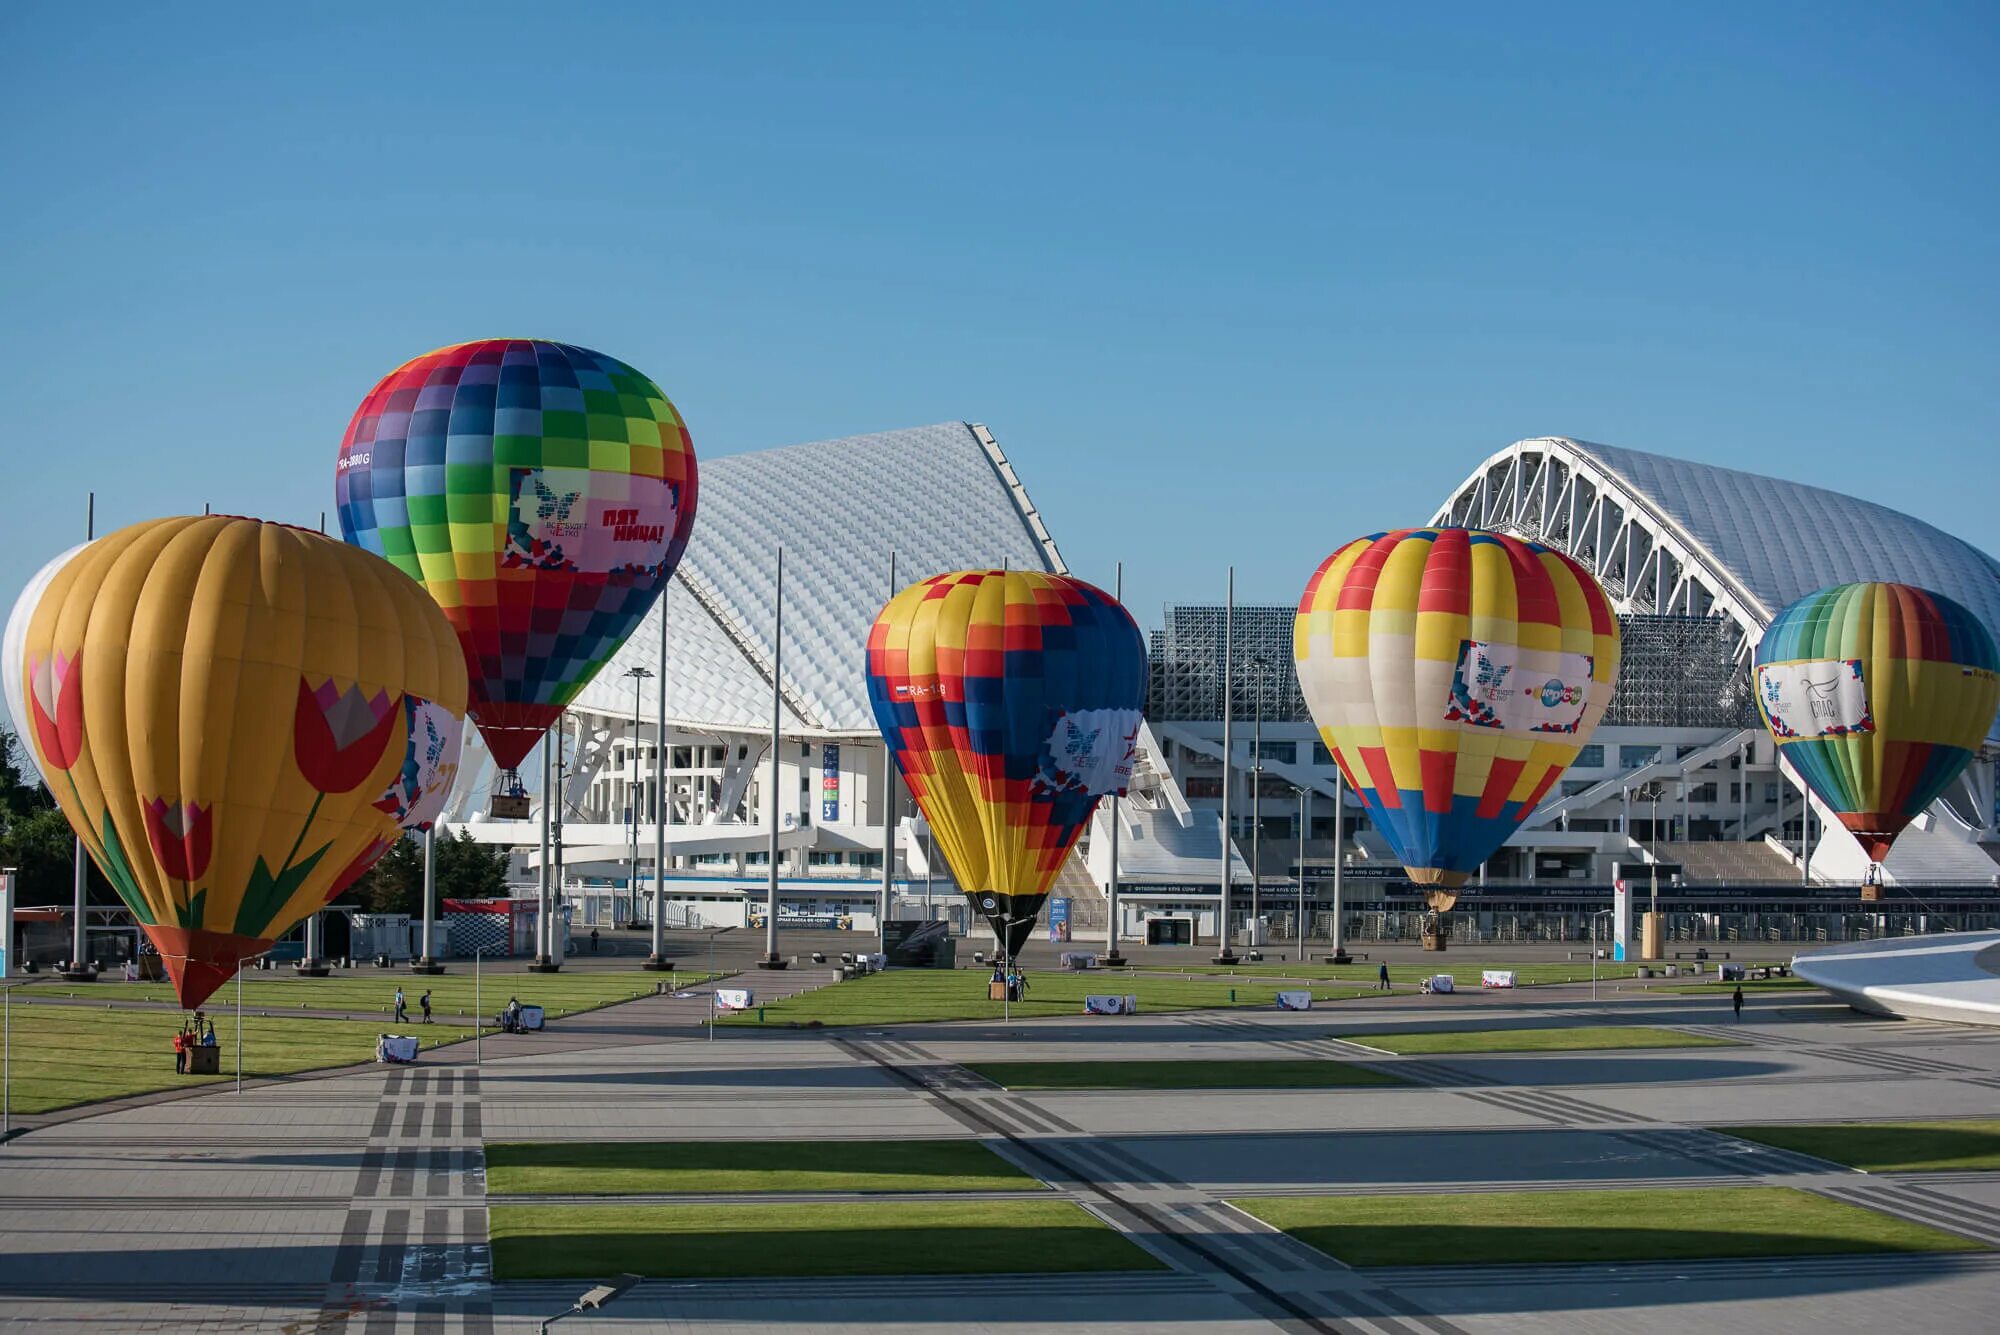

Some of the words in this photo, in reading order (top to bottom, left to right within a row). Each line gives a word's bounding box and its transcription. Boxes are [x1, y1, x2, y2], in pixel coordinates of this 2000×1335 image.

[602, 509, 639, 527] ПЯТ
[613, 525, 665, 544] НИЦА!
[1810, 699, 1835, 719] СПАС
[824, 803, 831, 817] 3
